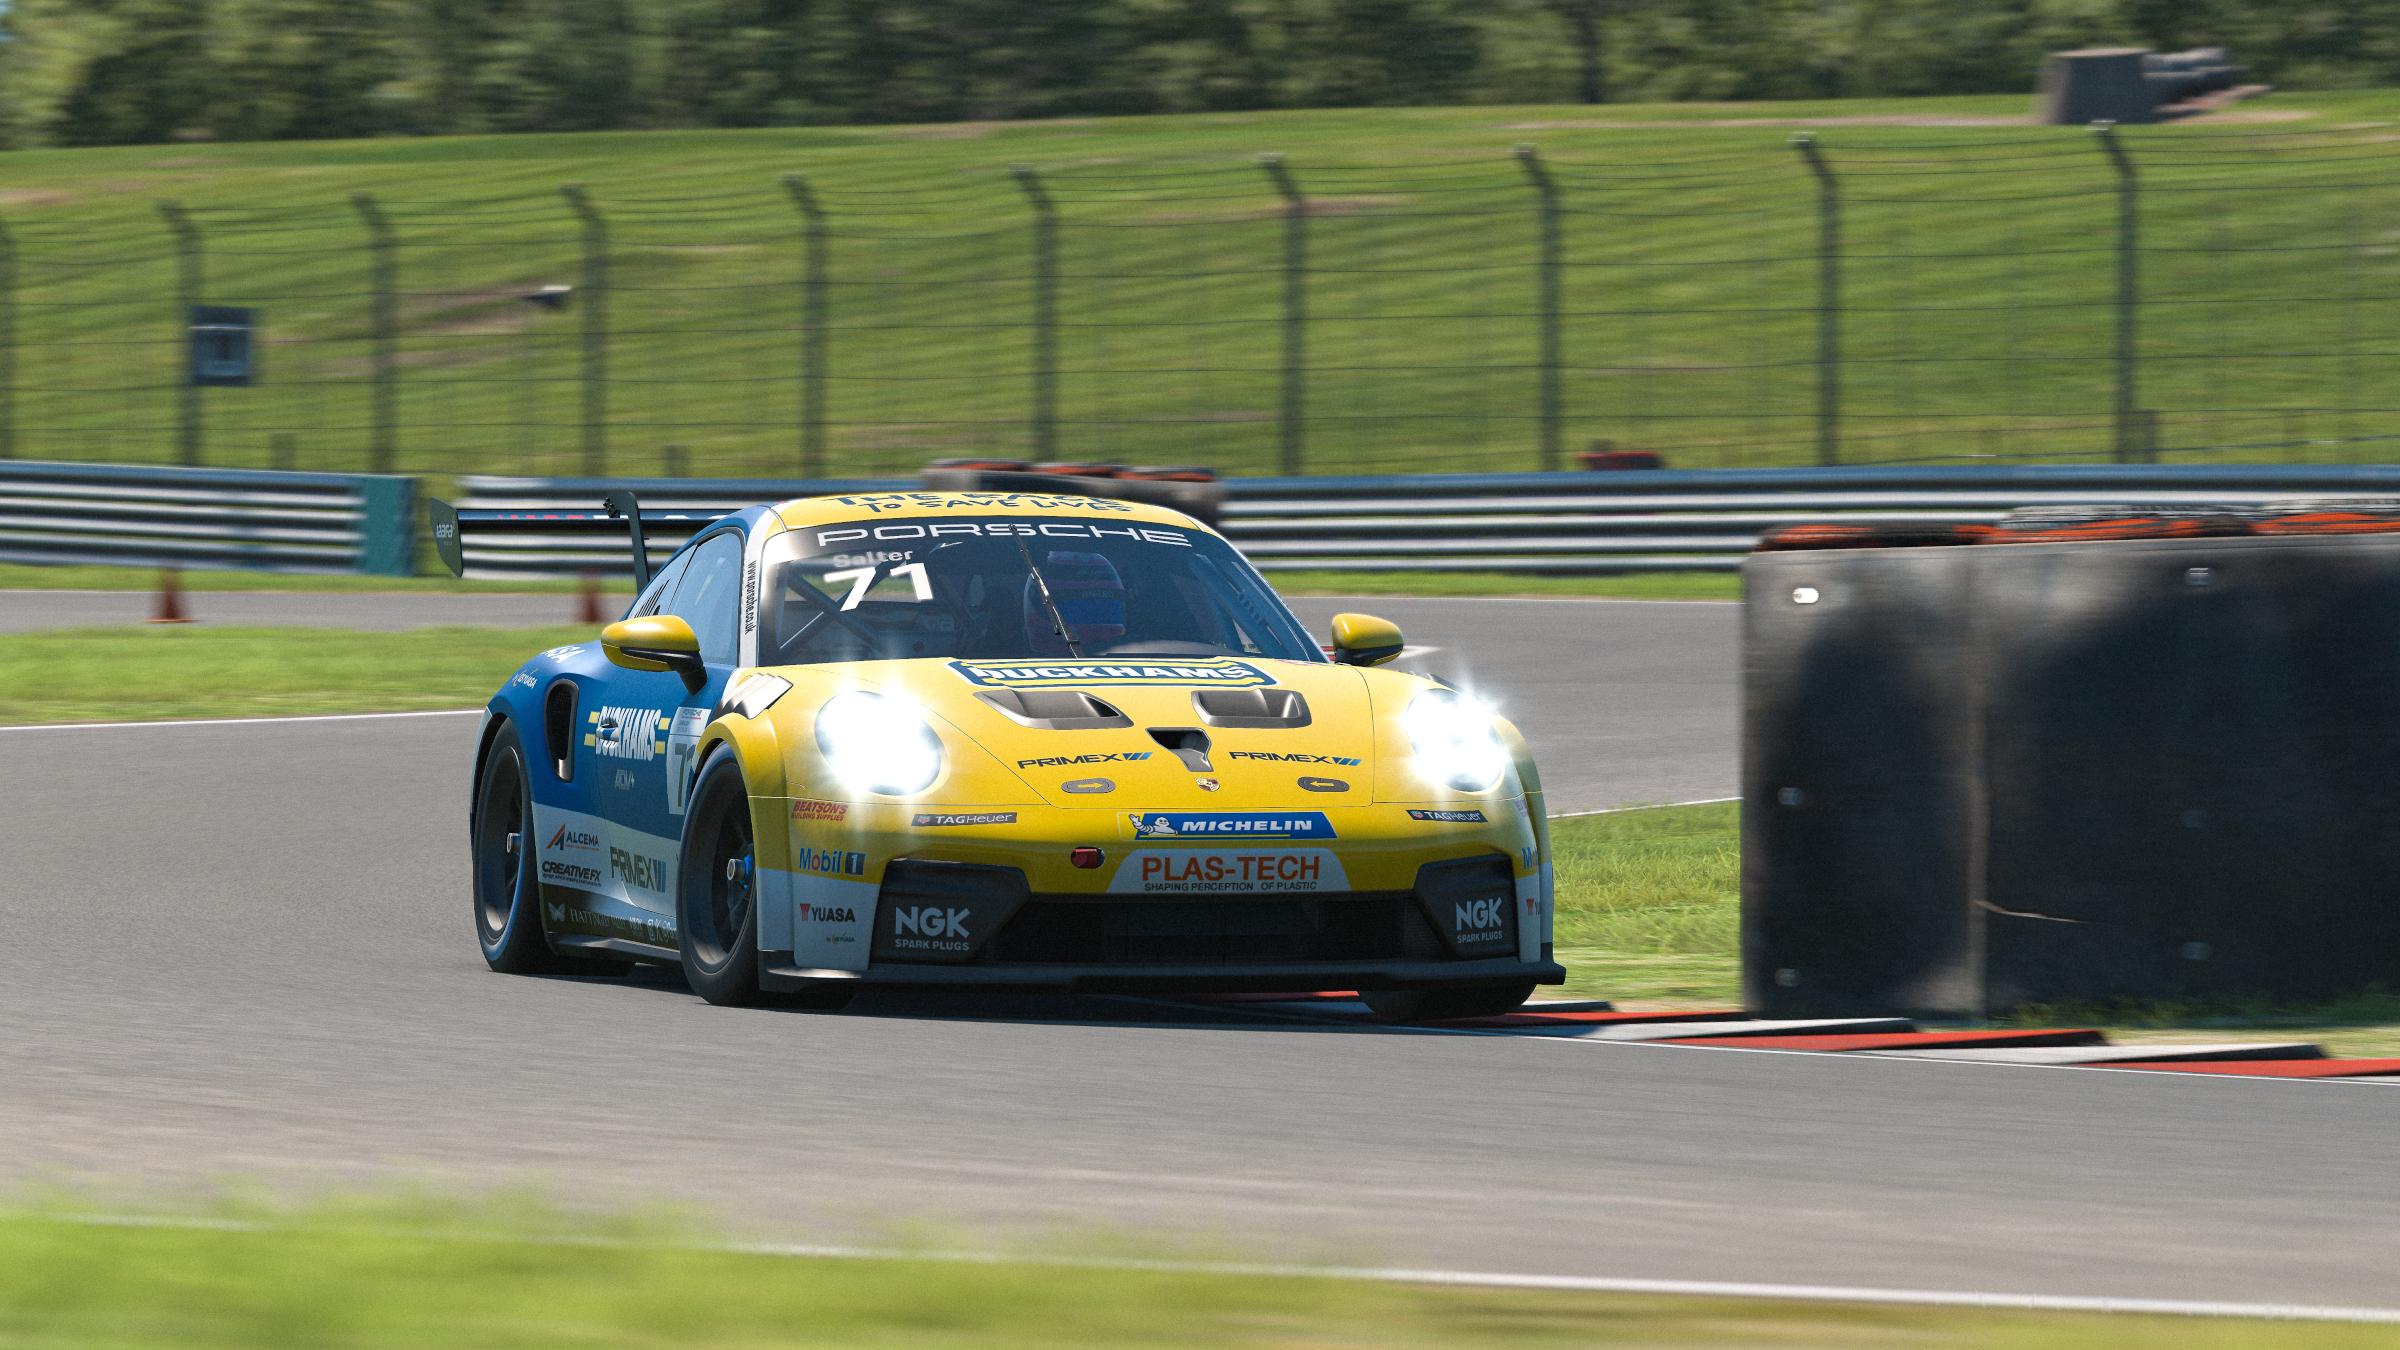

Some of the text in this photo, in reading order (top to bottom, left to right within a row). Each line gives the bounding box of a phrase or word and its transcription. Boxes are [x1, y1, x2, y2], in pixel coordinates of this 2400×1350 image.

[916, 499, 1020, 508] SAVE
[817, 523, 1192, 548] PORSCHE
[832, 550, 913, 568] Salter
[823, 562, 934, 612] 71
[966, 664, 1254, 680] DUCKHAMS
[1017, 753, 1123, 769] PRIMEX
[1229, 751, 1335, 765] PRIMEX
[1182, 819, 1313, 832] MICHELIN
[566, 831, 600, 847] ALCEMA
[610, 846, 656, 892] PRIMEX
[799, 848, 842, 874] Mobil
[1142, 855, 1320, 880] PLAS-TECH
[1144, 881, 1318, 892] SHAPING PERCEPTION OF PLASTIC
[811, 907, 855, 923] YUASA
[1455, 897, 1503, 931] NGK
[895, 906, 971, 939] NGK
[895, 938, 970, 951] SPARK PLUGS
[1457, 930, 1503, 944] SPARK PLUGS
